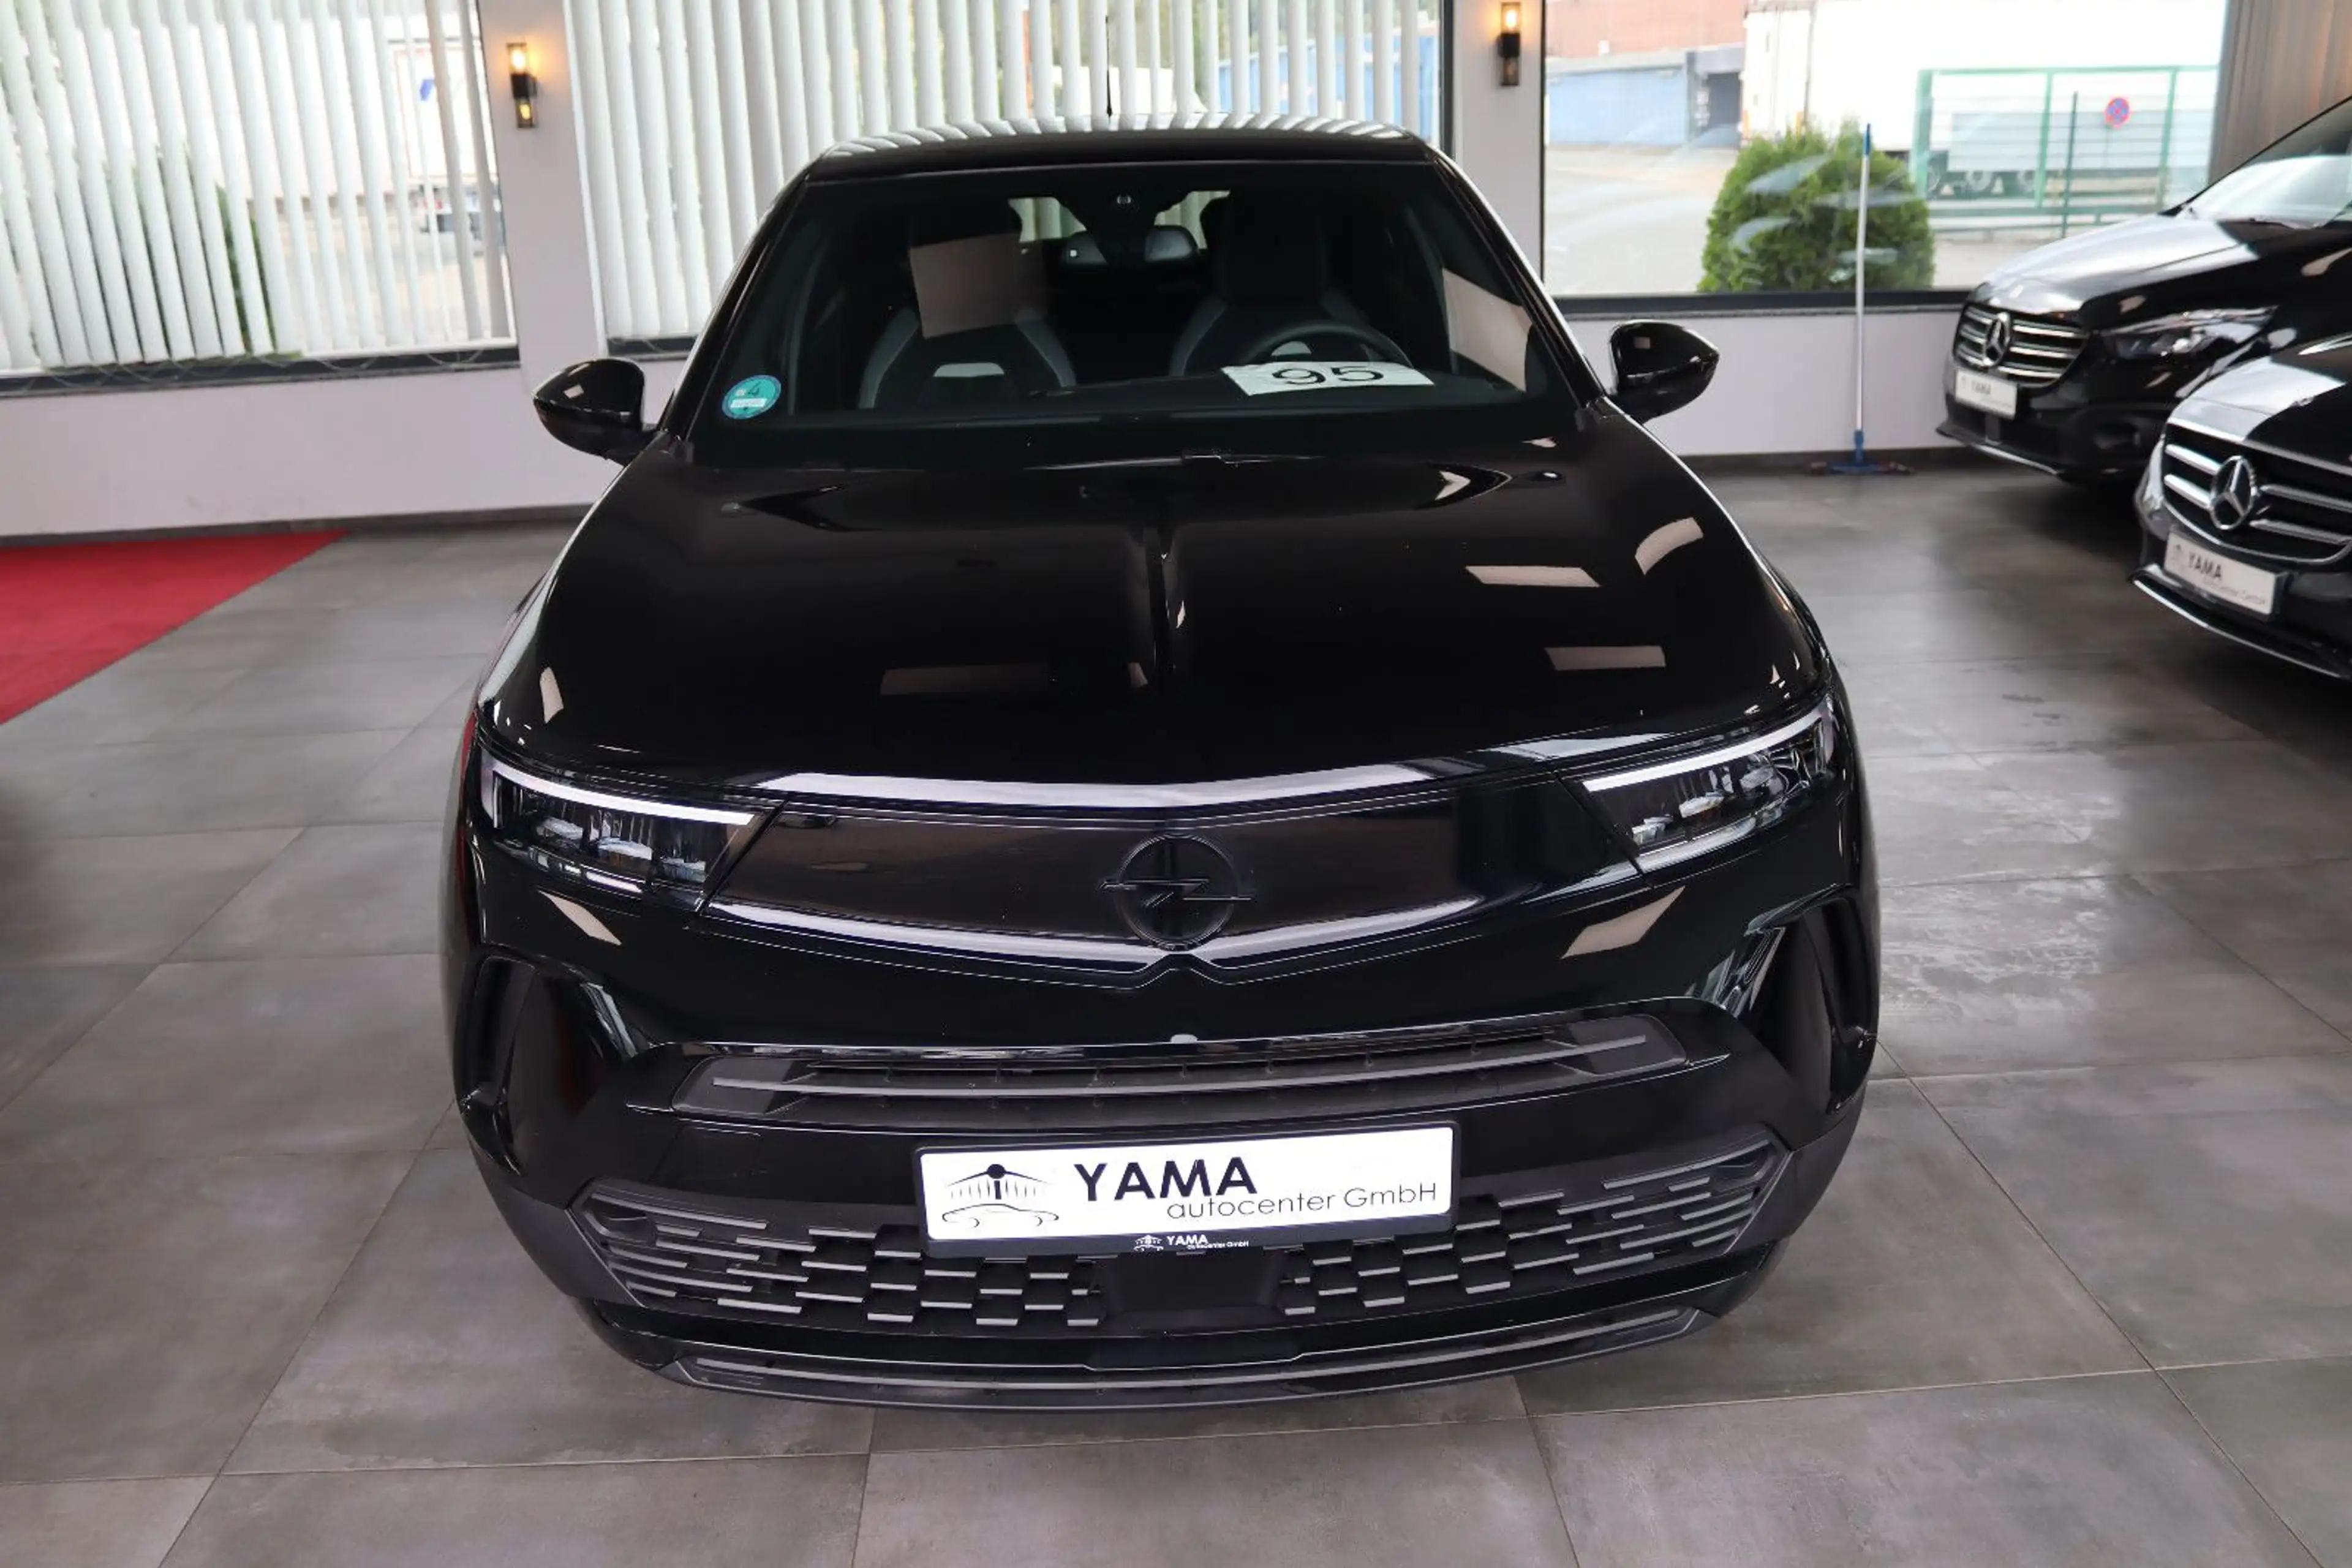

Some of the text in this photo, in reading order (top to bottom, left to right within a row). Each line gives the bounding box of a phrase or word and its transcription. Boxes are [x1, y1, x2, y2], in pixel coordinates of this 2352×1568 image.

[1272, 366, 1384, 385] 95
[2188, 552, 2222, 579] YAMA
[1073, 1157, 1258, 1201] YAMA
[1167, 1182, 1436, 1218] autocenter GmbH
[1166, 1234, 1209, 1246] YAMA
